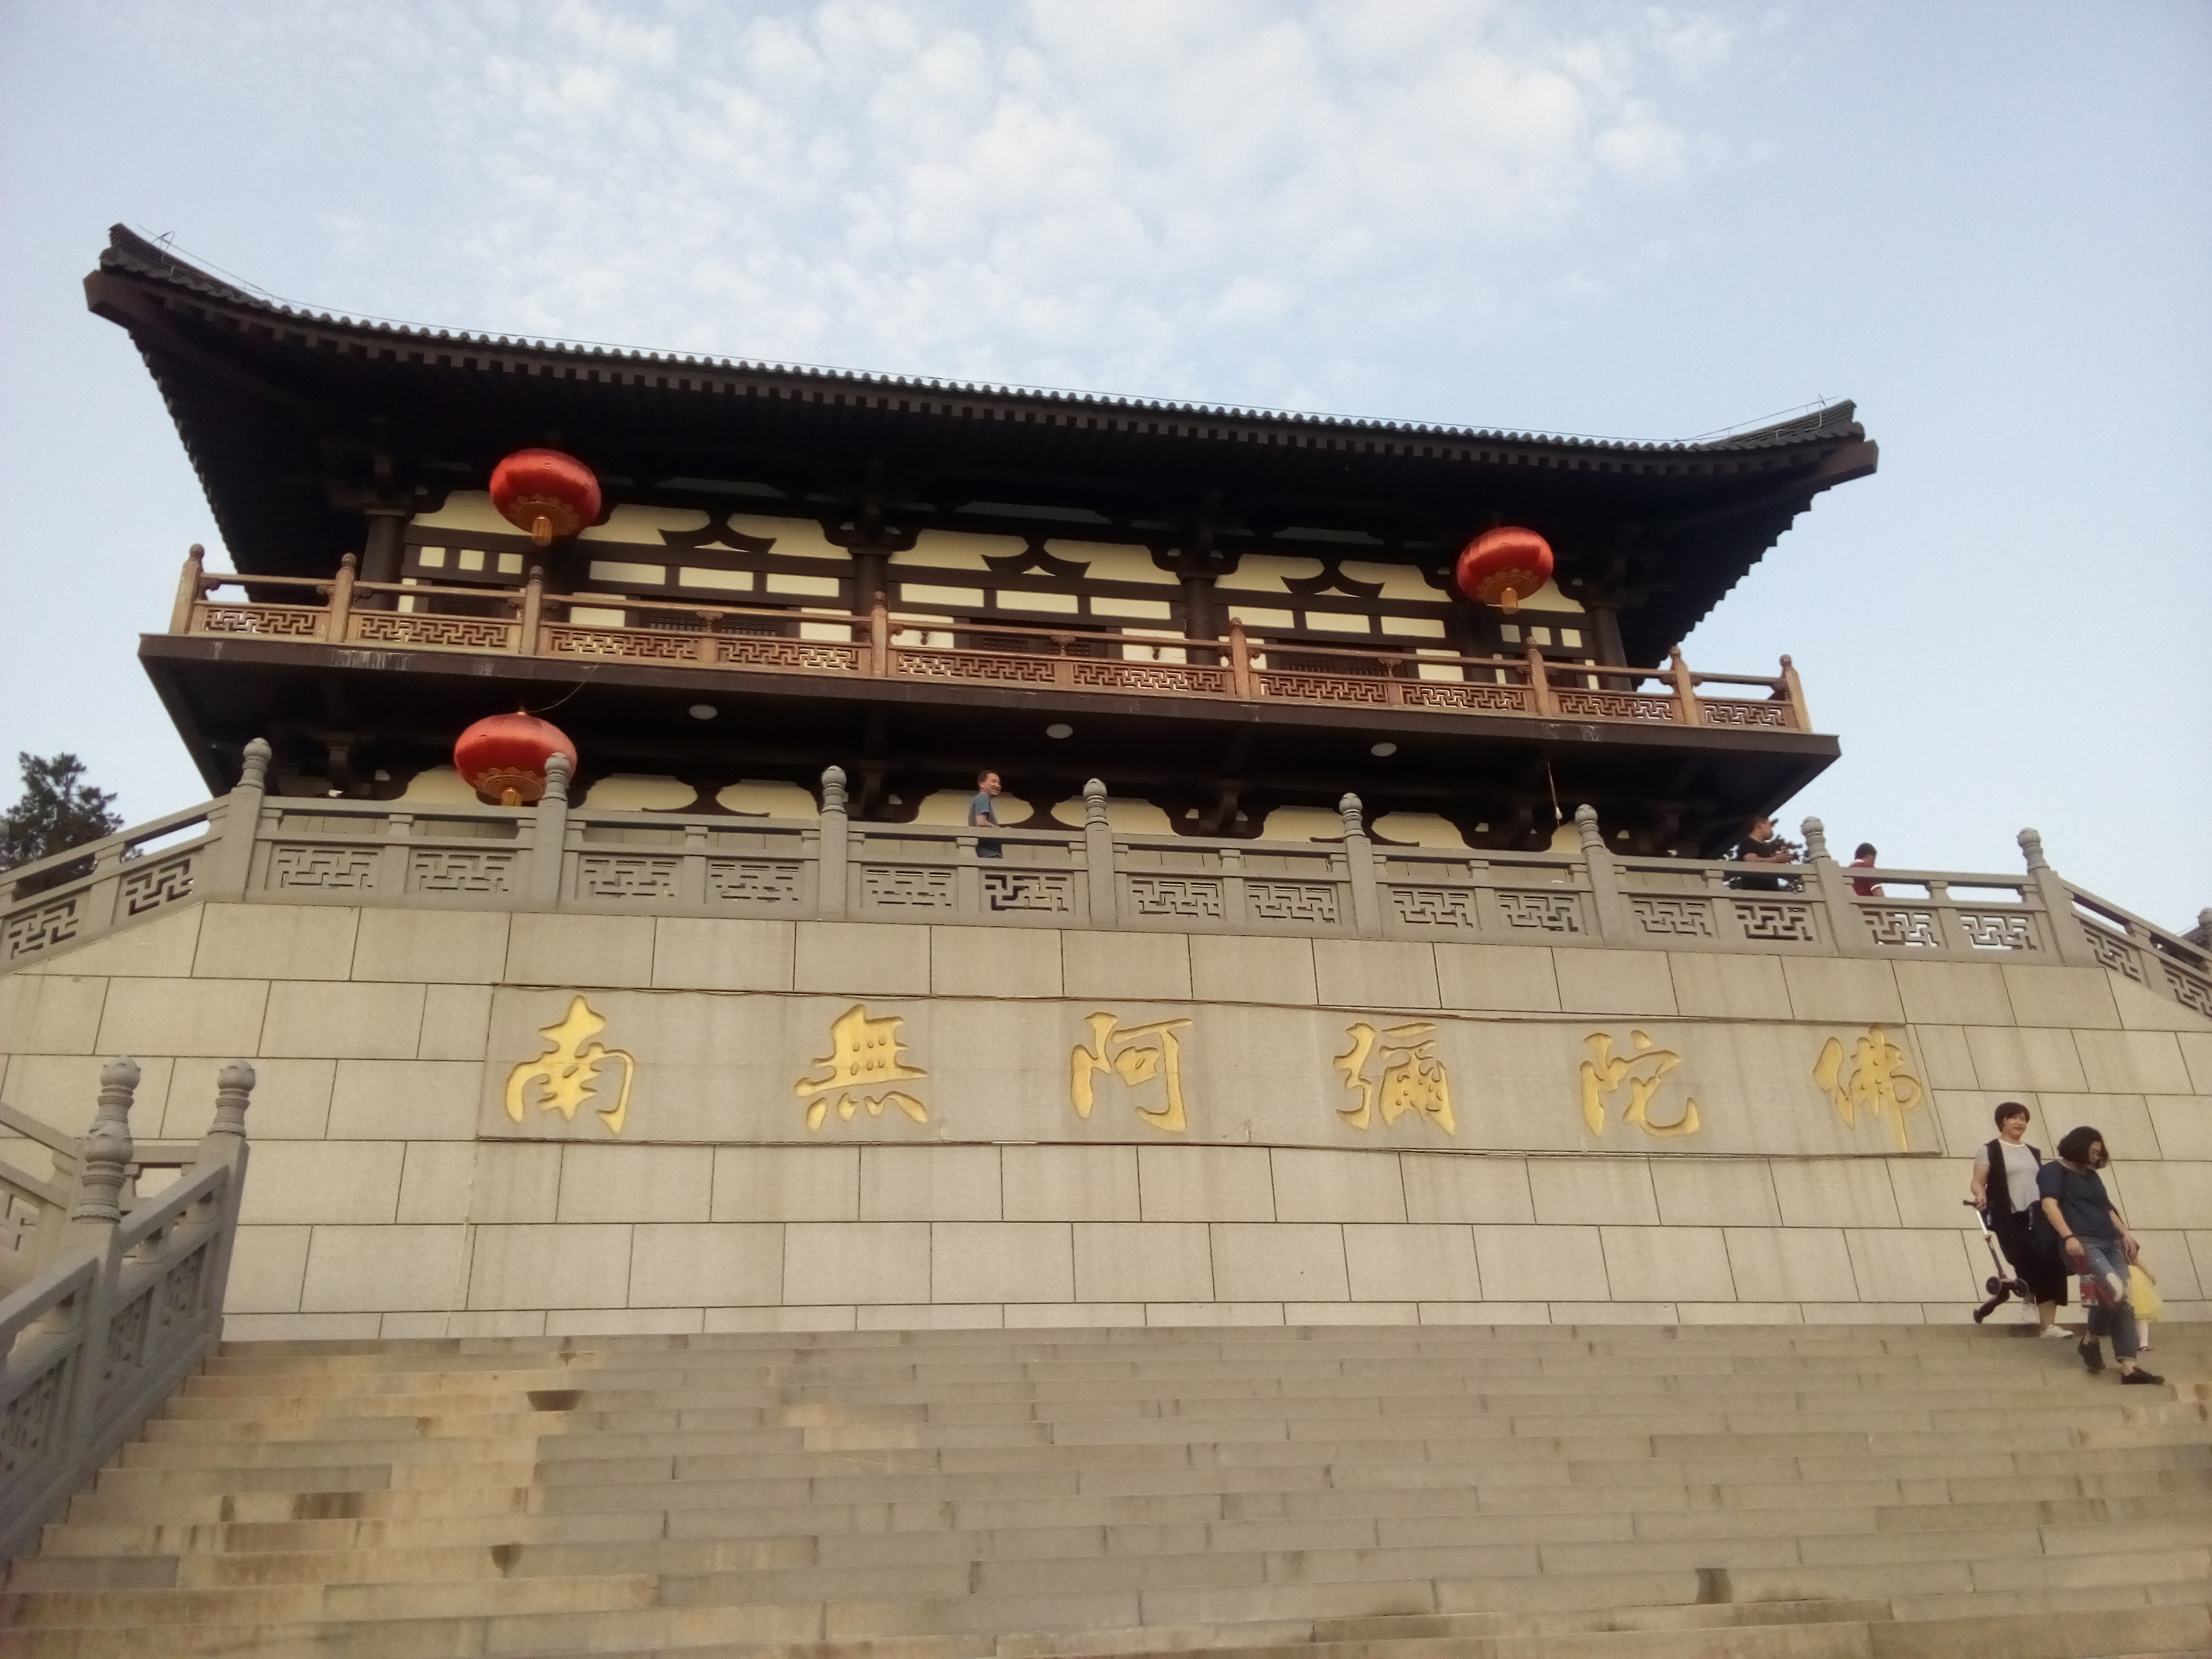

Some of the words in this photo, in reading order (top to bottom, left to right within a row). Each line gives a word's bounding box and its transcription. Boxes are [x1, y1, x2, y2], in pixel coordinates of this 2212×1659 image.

[503, 994, 1923, 1153] 南無阿彌陀佛
